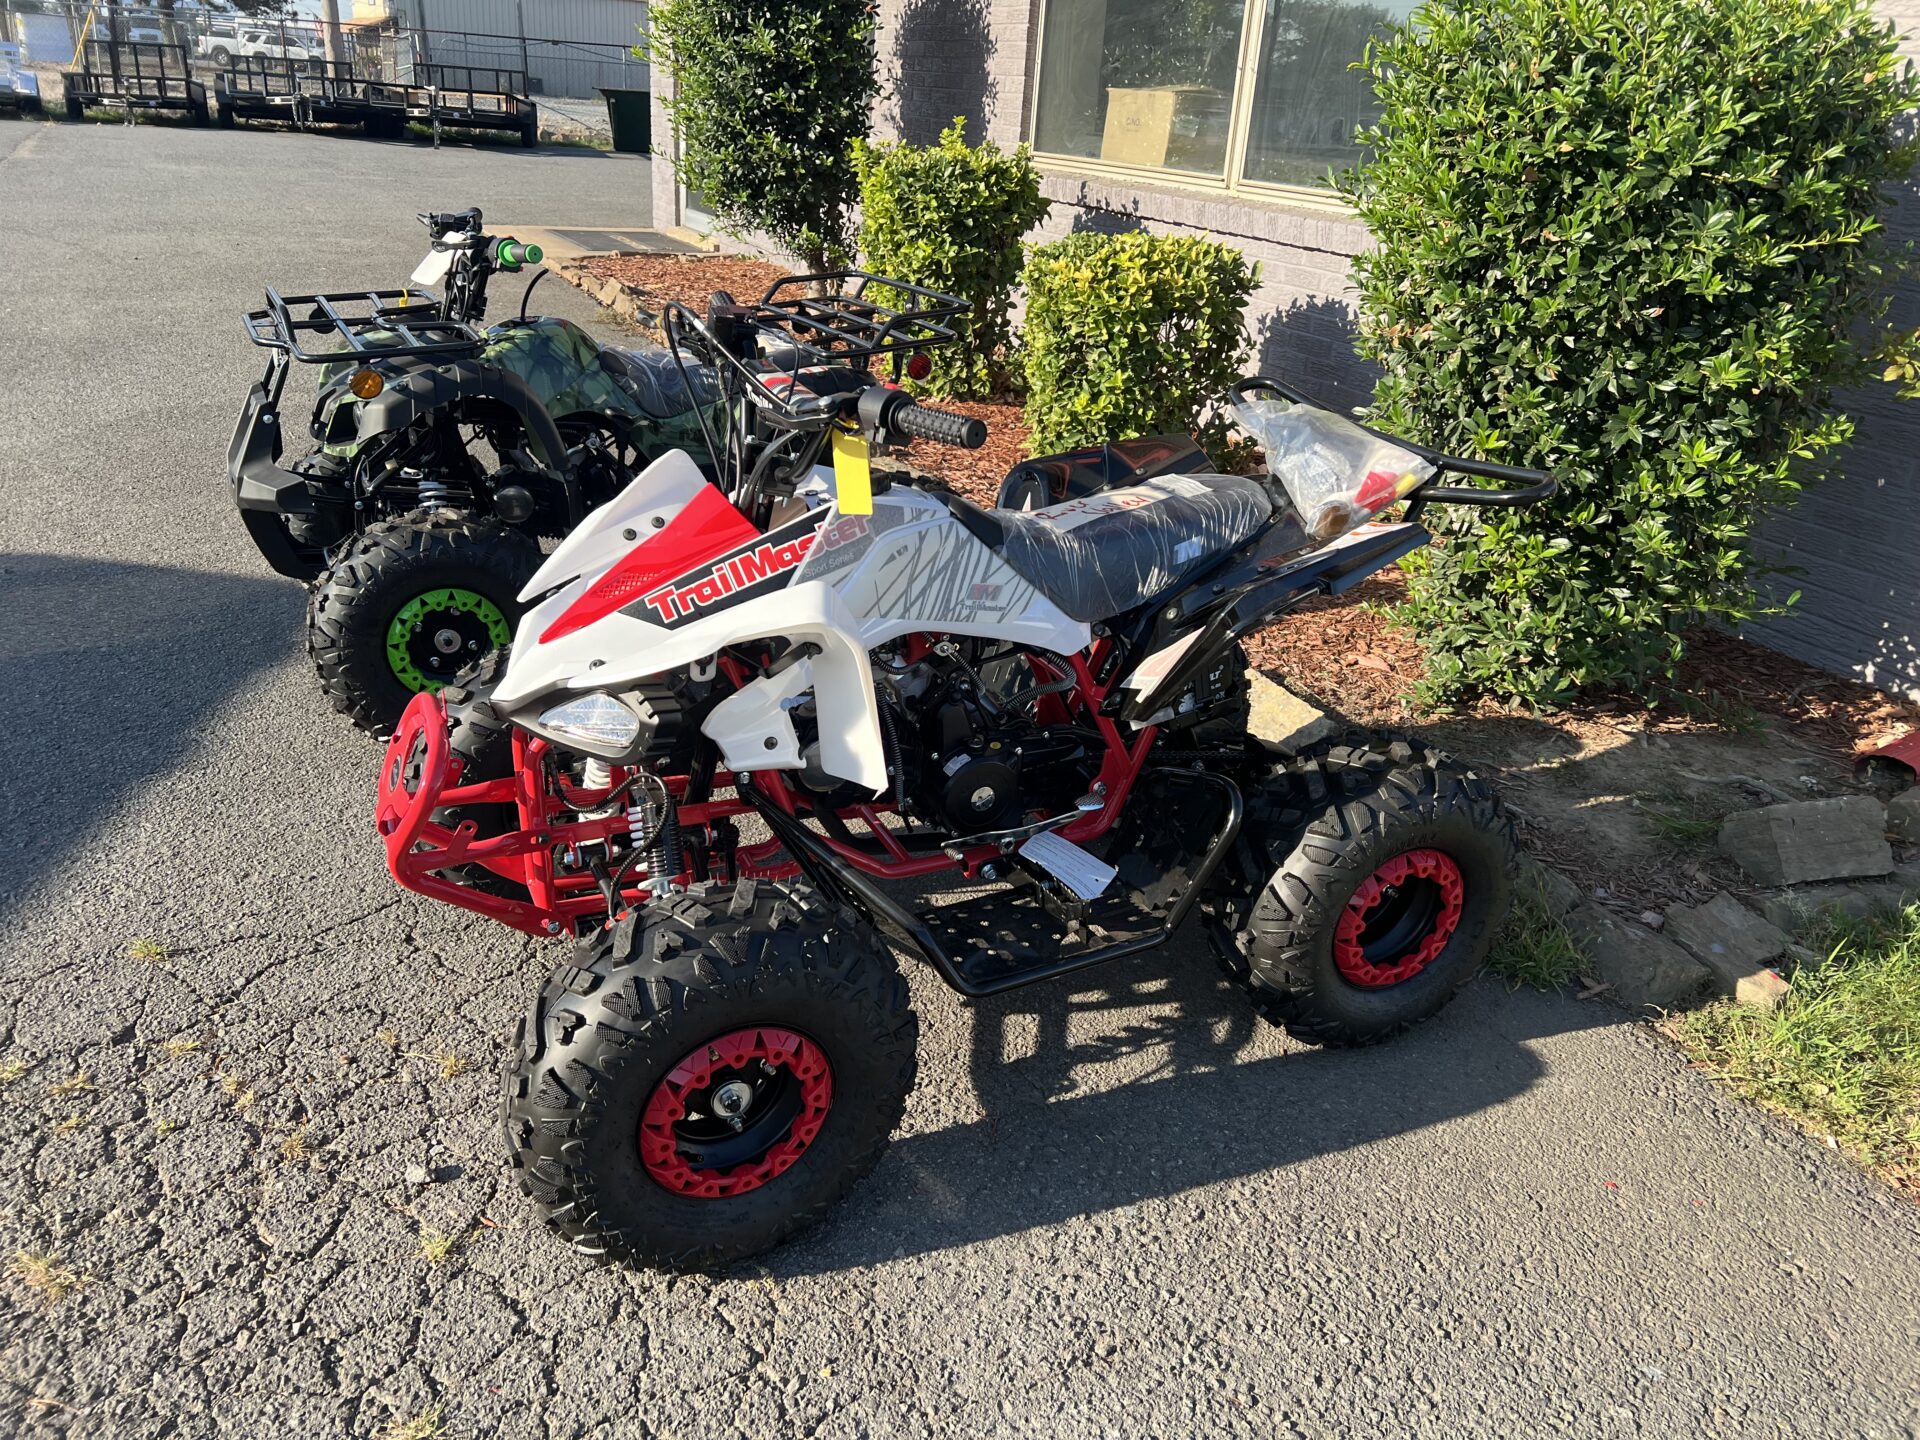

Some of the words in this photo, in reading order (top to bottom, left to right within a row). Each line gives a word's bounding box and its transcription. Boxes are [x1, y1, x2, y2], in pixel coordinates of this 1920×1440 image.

[644, 512, 872, 624] TrailMaster
[803, 562, 828, 578] Sport
[828, 551, 855, 569] Series
